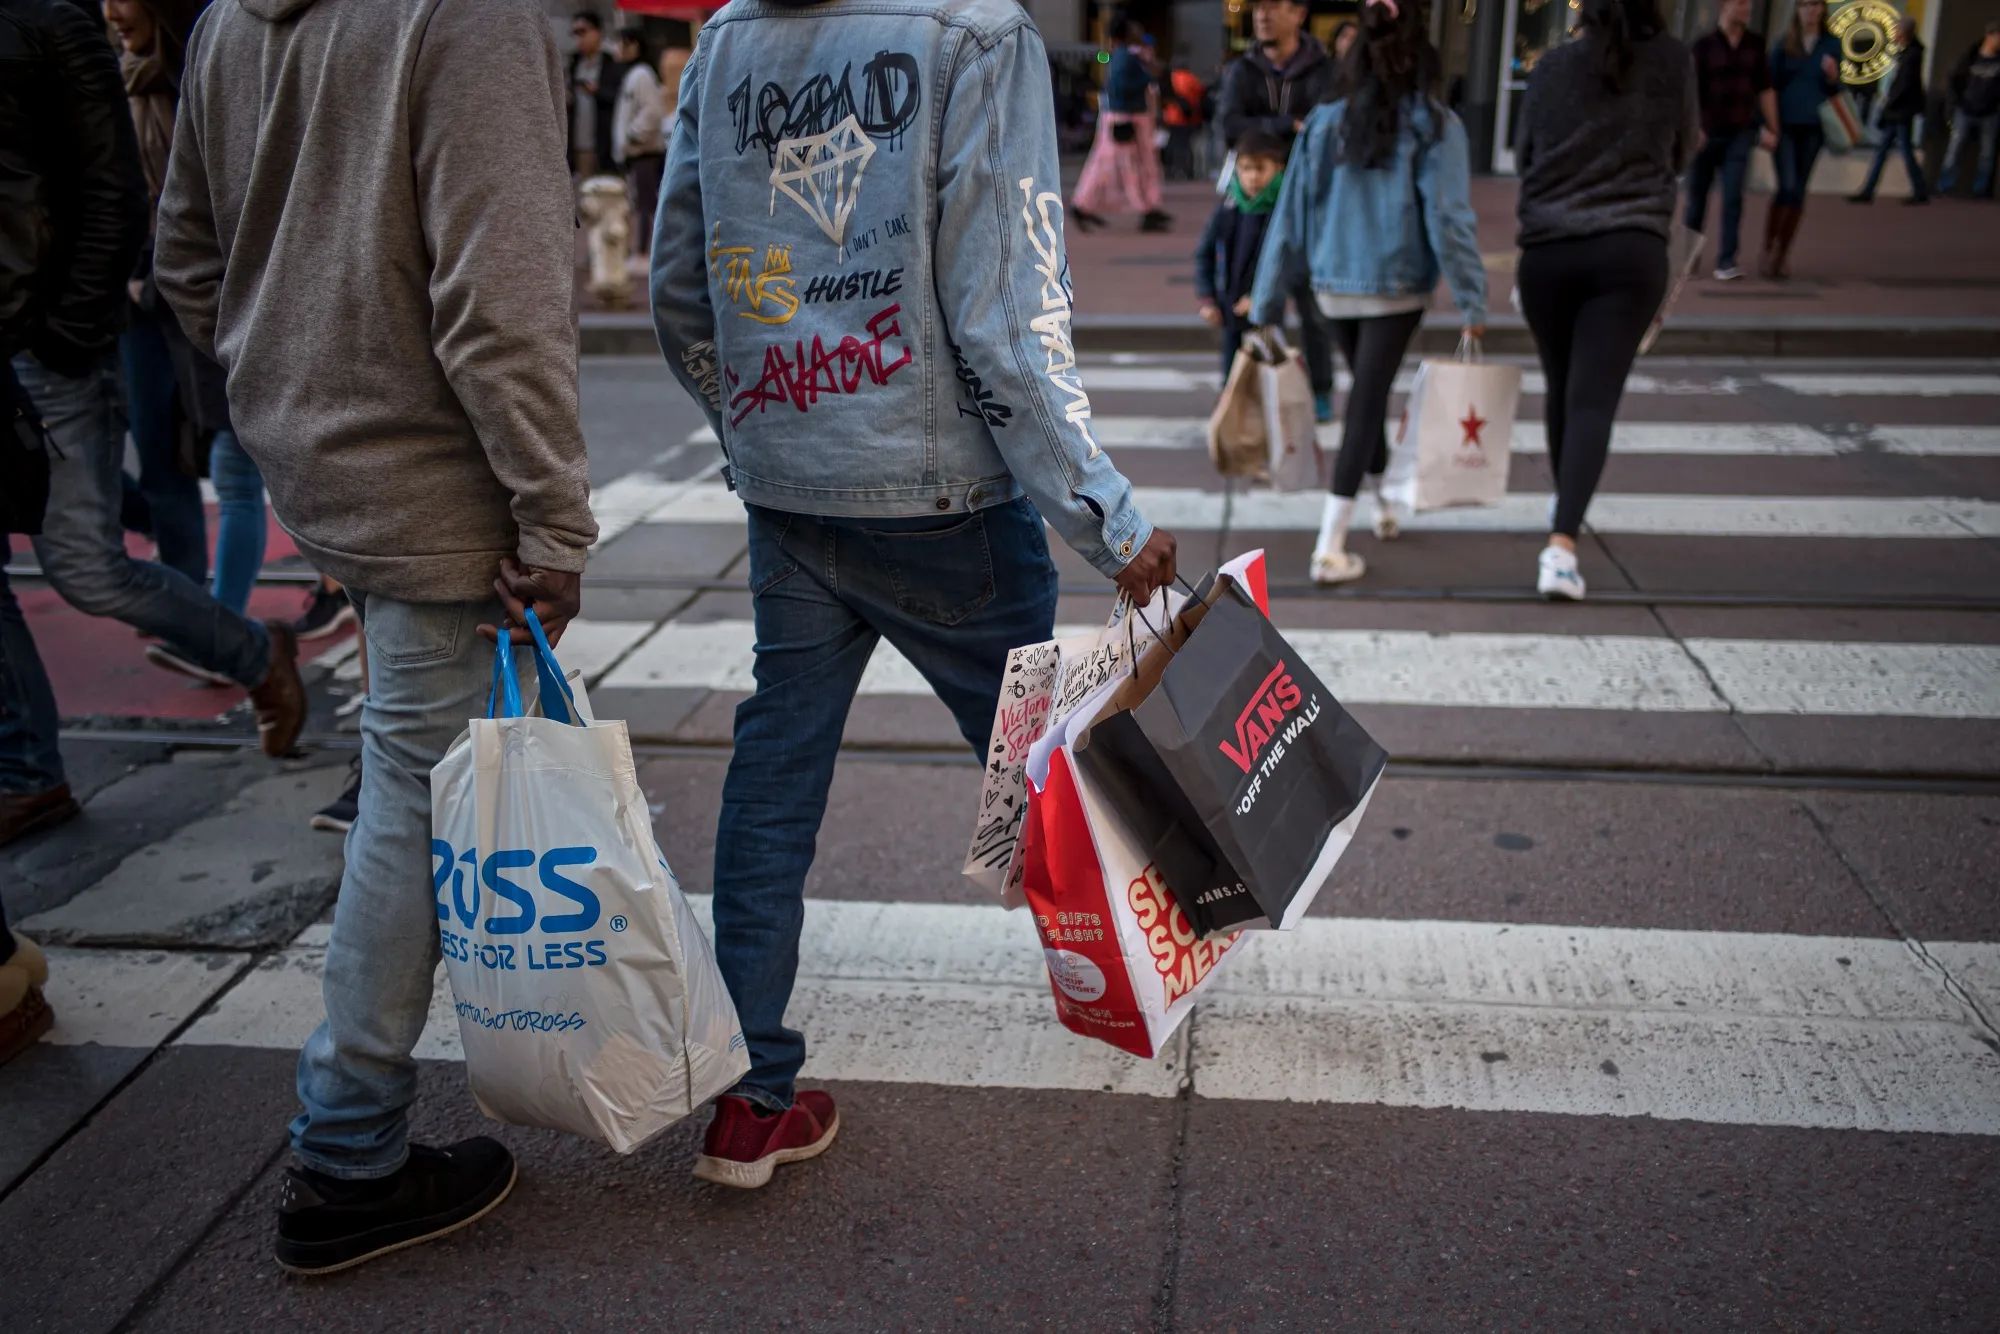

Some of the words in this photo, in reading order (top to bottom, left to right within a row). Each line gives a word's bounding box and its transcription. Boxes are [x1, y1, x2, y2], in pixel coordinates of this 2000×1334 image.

[852, 228, 878, 253] DON'T
[884, 214, 911, 239] CARE
[803, 268, 904, 304] HUSTLE
[724, 303, 912, 431] SAVAGE
[1218, 659, 1303, 774] VANS
[1261, 740, 1286, 778] THE
[1047, 928, 1104, 942] FLASH?
[1056, 912, 1101, 926] GIFTS
[528, 940, 607, 970] LESS
